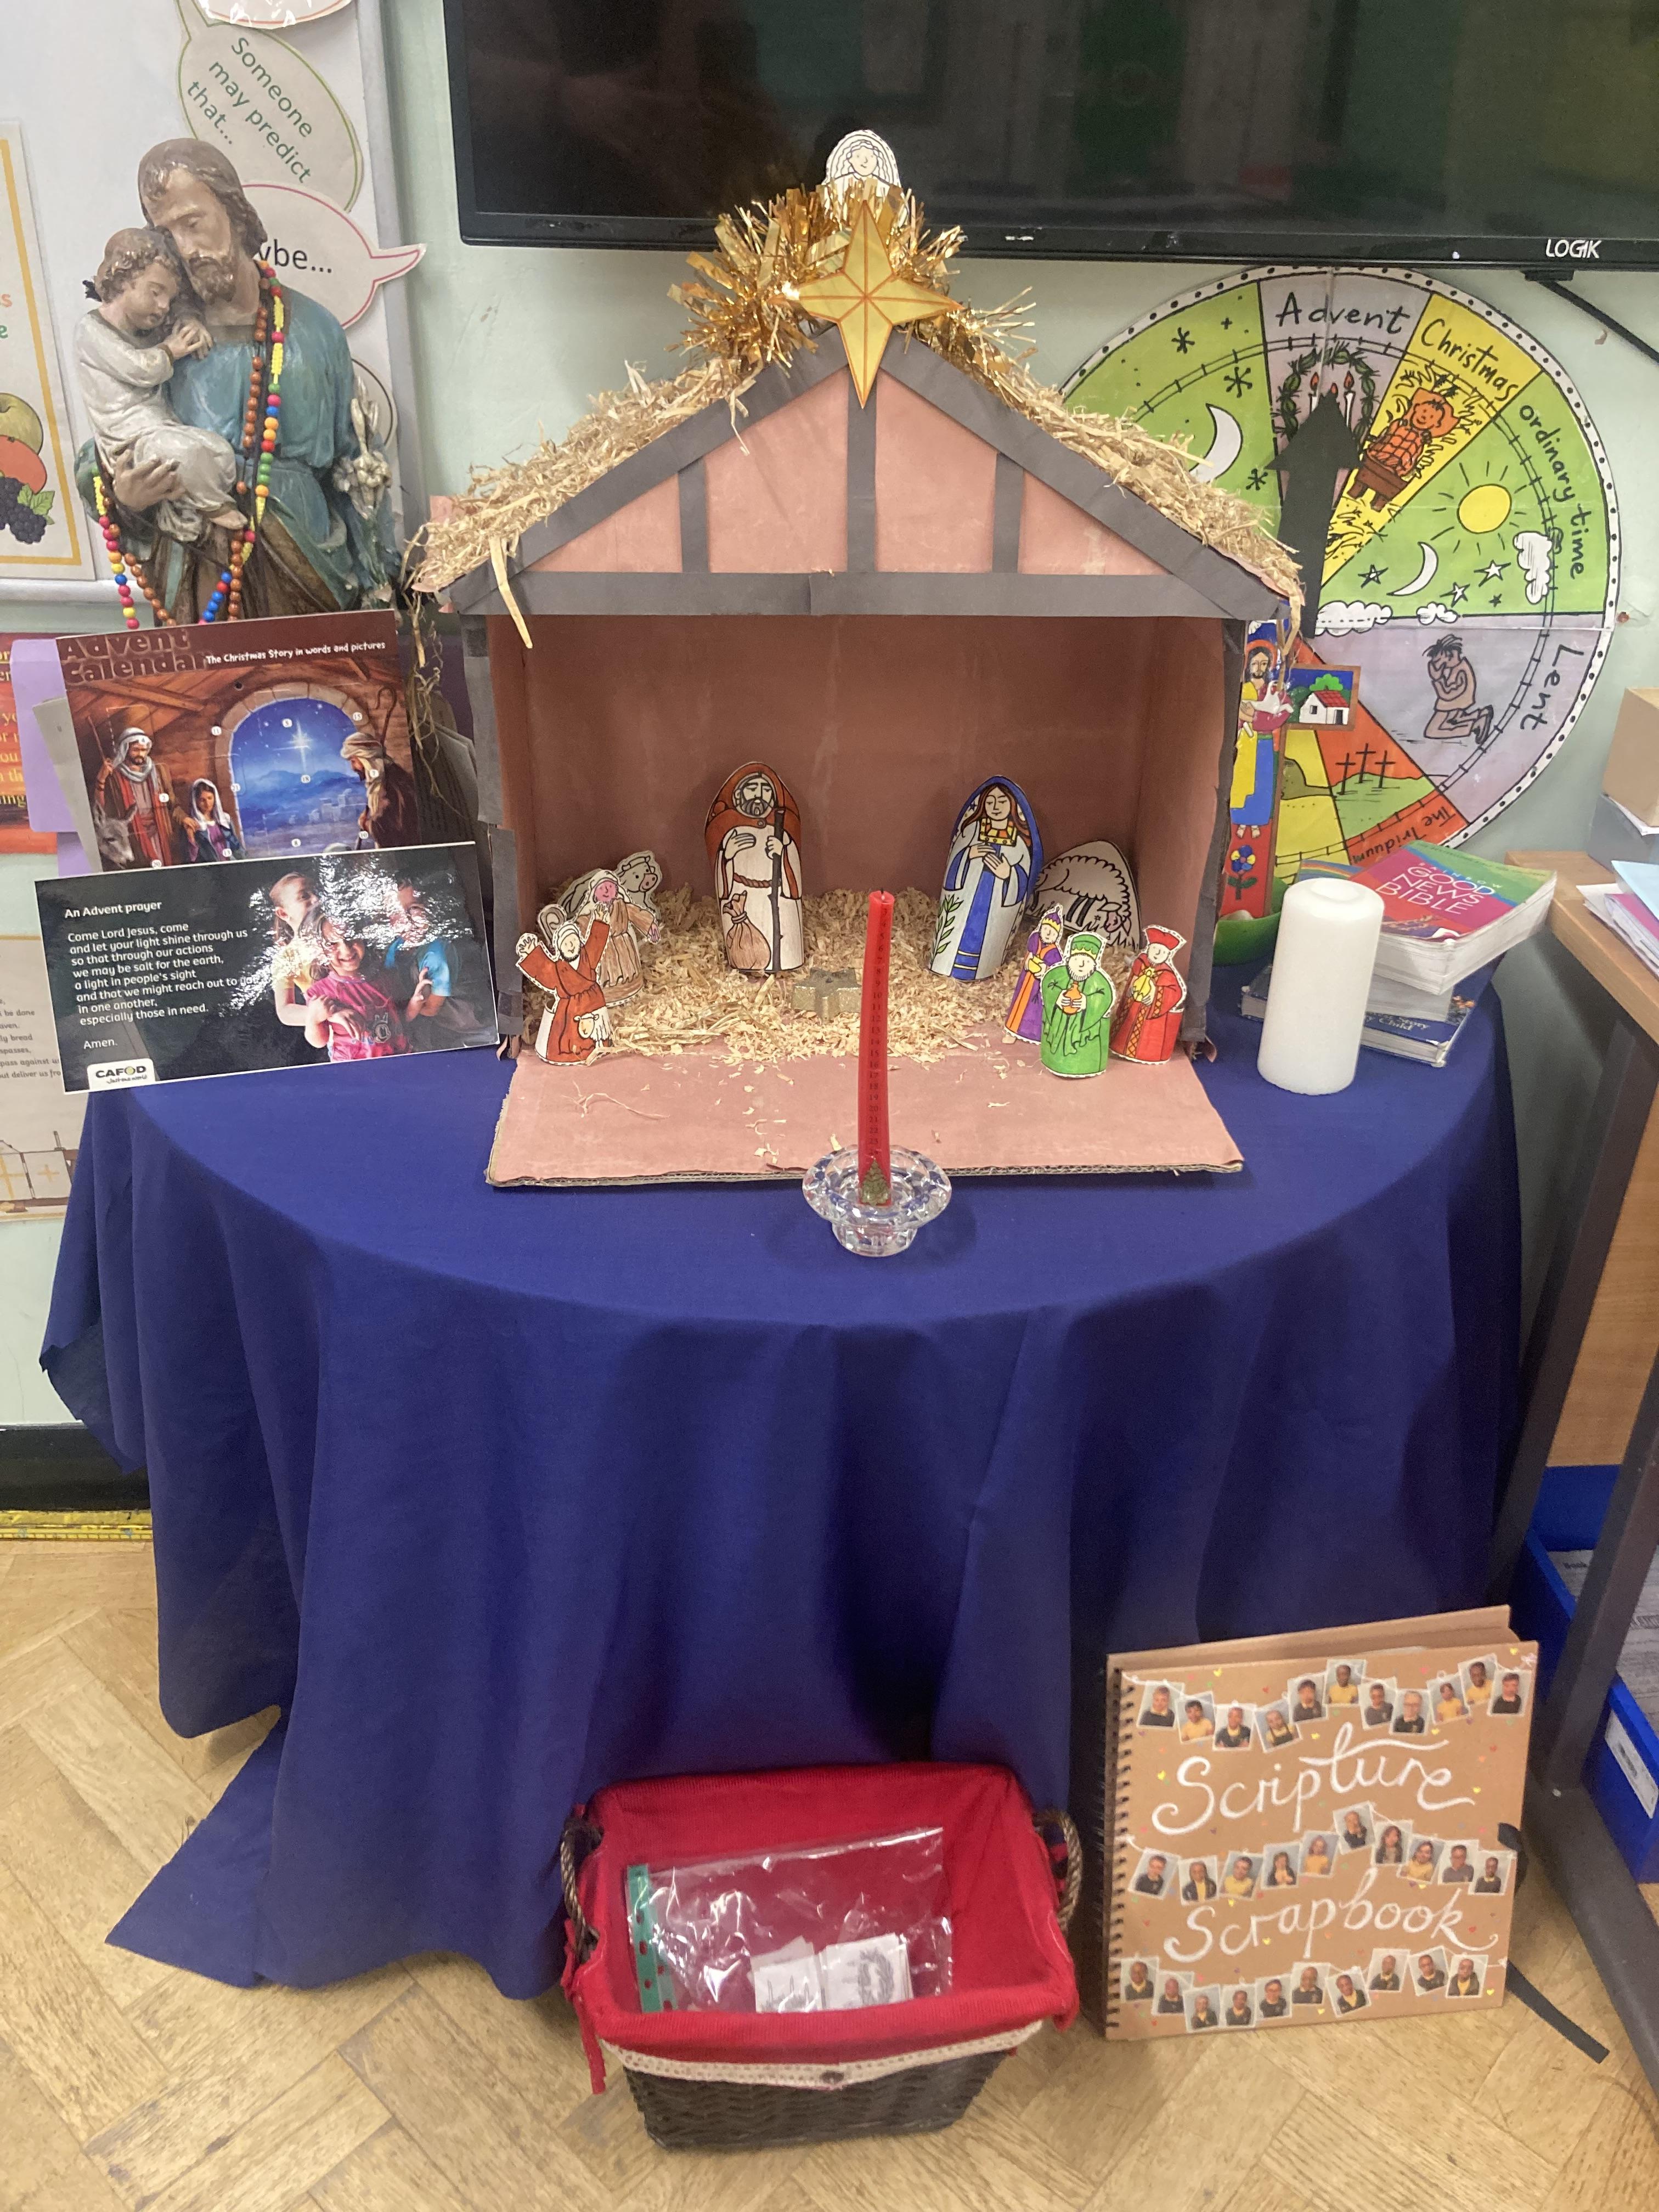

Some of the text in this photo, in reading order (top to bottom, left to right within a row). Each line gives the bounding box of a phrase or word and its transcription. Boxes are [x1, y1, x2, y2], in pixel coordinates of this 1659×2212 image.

[231, 37, 312, 138] Someone
[208, 61, 311, 183] may predict
[1545, 239, 1602, 258] LOGIK
[1276, 292, 1410, 334] Advent
[1421, 318, 1519, 402] Christmas
[1570, 503, 1592, 579] time
[60, 629, 190, 662] Advent
[205, 655, 222, 664] The
[224, 651, 266, 663] Christmas
[268, 648, 293, 659] Story
[305, 645, 331, 655] words
[333, 643, 348, 653] and
[351, 641, 386, 653] pictures
[1520, 644, 1584, 730] Lent
[1421, 806, 1456, 827] The
[1407, 866, 1496, 895] GOOD
[1418, 862, 1503, 888] RAINBOW
[1375, 882, 1473, 915] BIBLE
[1392, 873, 1484, 905] NEWS
[64, 901, 162, 918] An Advent prayer
[67, 932, 99, 942] Come
[101, 928, 125, 940] Lord
[160, 923, 189, 933] come
[70, 930, 248, 954] and let your light shine through us
[71, 944, 213, 966] so that through our actions
[72, 955, 224, 978] we may be salt for the earth,
[75, 969, 198, 990] a light in people's sight
[76, 991, 97, 1002] and
[99, 989, 123, 1000] that
[124, 988, 139, 997] we
[142, 984, 173, 996] might
[175, 980, 204, 991] reach
[206, 980, 224, 989] out
[226, 978, 238, 986] to
[78, 1005, 89, 1014] in
[91, 1003, 111, 1013] one
[80, 1003, 209, 1026] especially those in need.
[83, 1039, 118, 1049] Amen.
[0, 1060, 18, 1068] pass
[20, 1058, 50, 1067] against
[49, 1069, 61, 1078] fro
[95, 1065, 146, 1078] CAFOD
[1152, 1722, 1476, 1835] Scripture
[1163, 1867, 1498, 1963] Scrapbook
